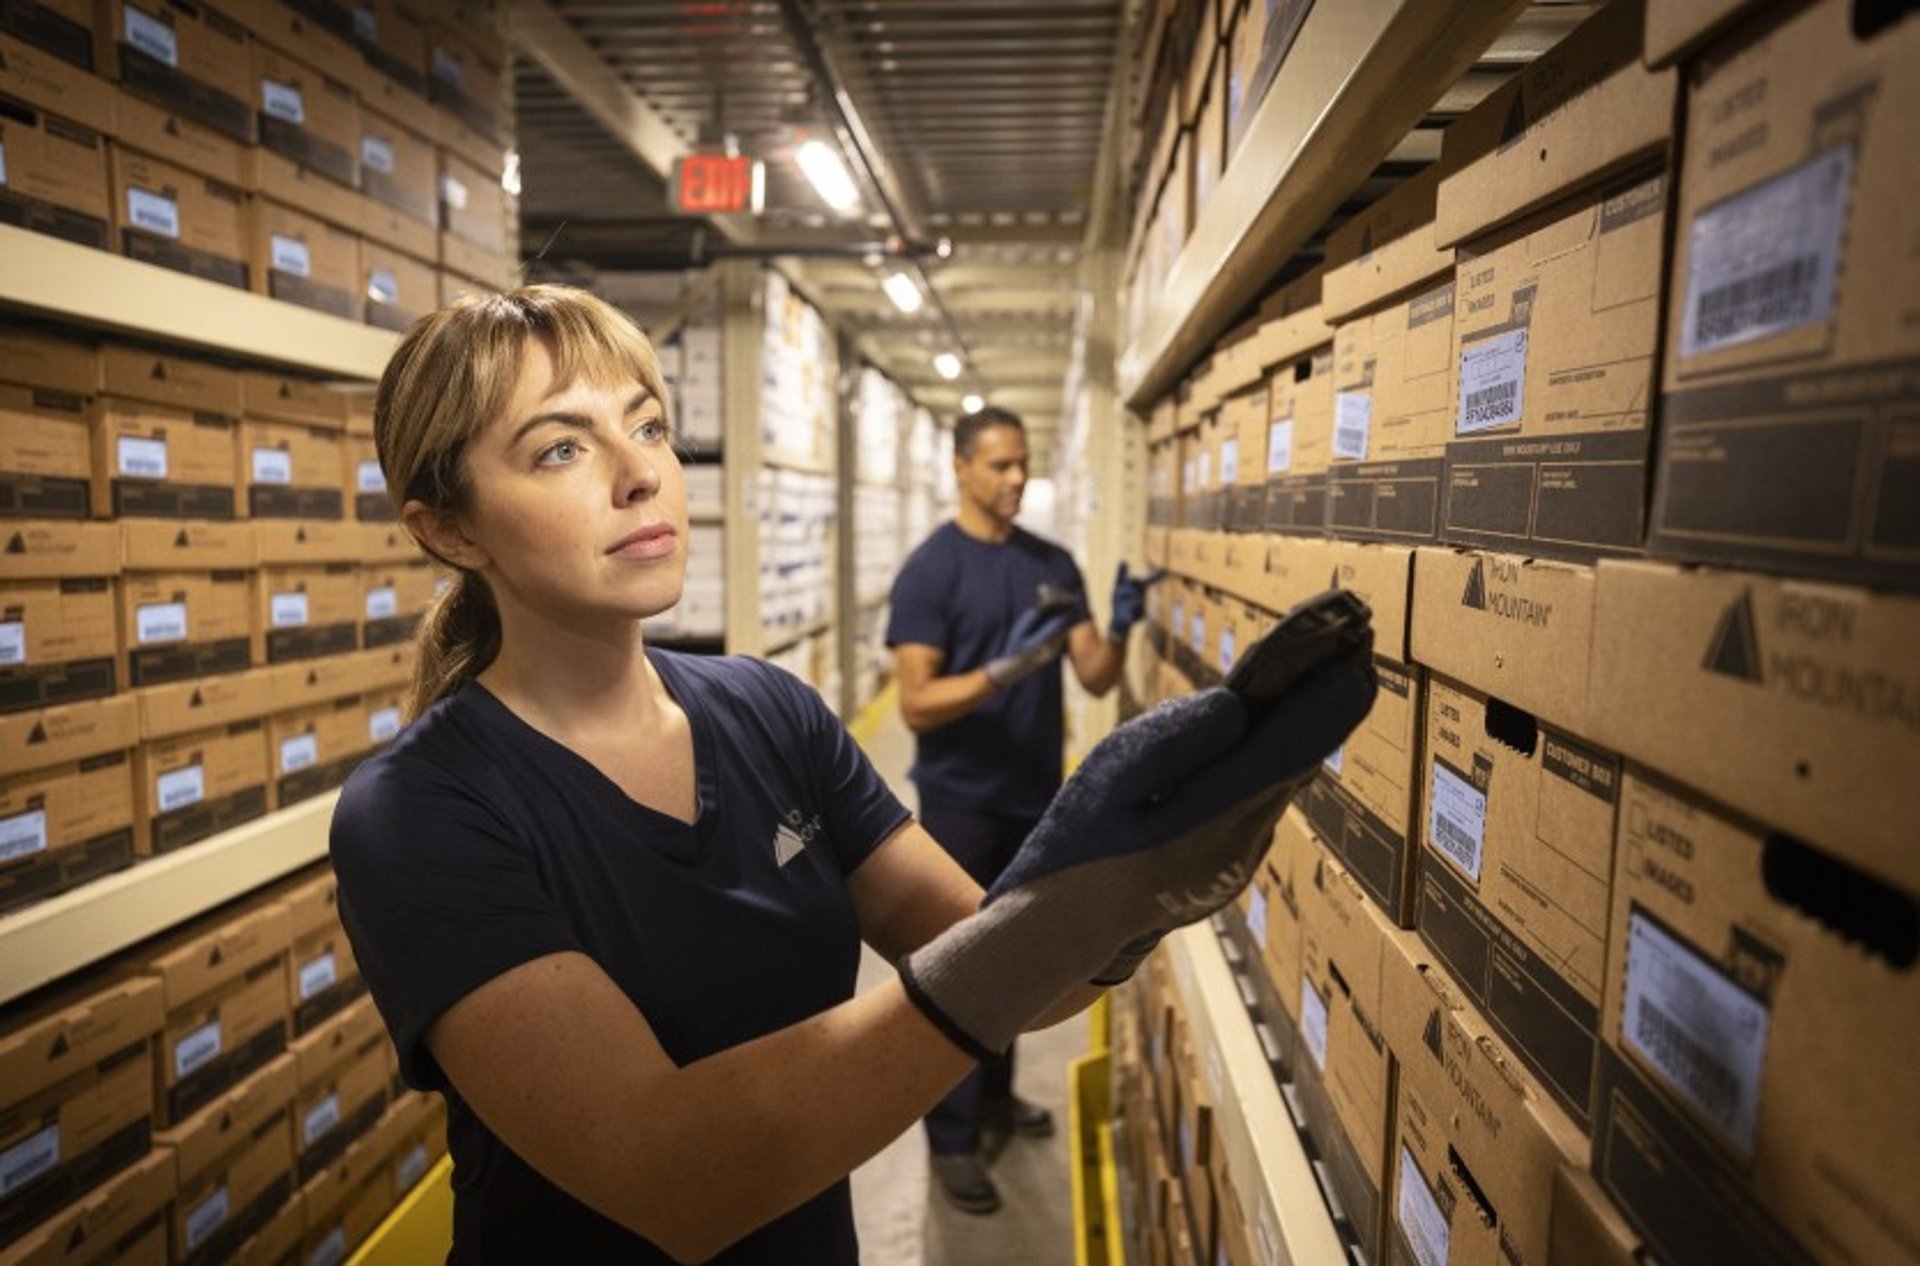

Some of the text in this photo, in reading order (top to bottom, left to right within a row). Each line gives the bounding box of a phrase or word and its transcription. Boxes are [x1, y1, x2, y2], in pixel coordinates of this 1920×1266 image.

[682, 156, 748, 211] EXIT
[1546, 742, 1590, 776] CUSTOMER
[1592, 763, 1612, 786] BOX
[1648, 820, 1694, 861] LISTED
[1644, 858, 1695, 906] IMAGES
